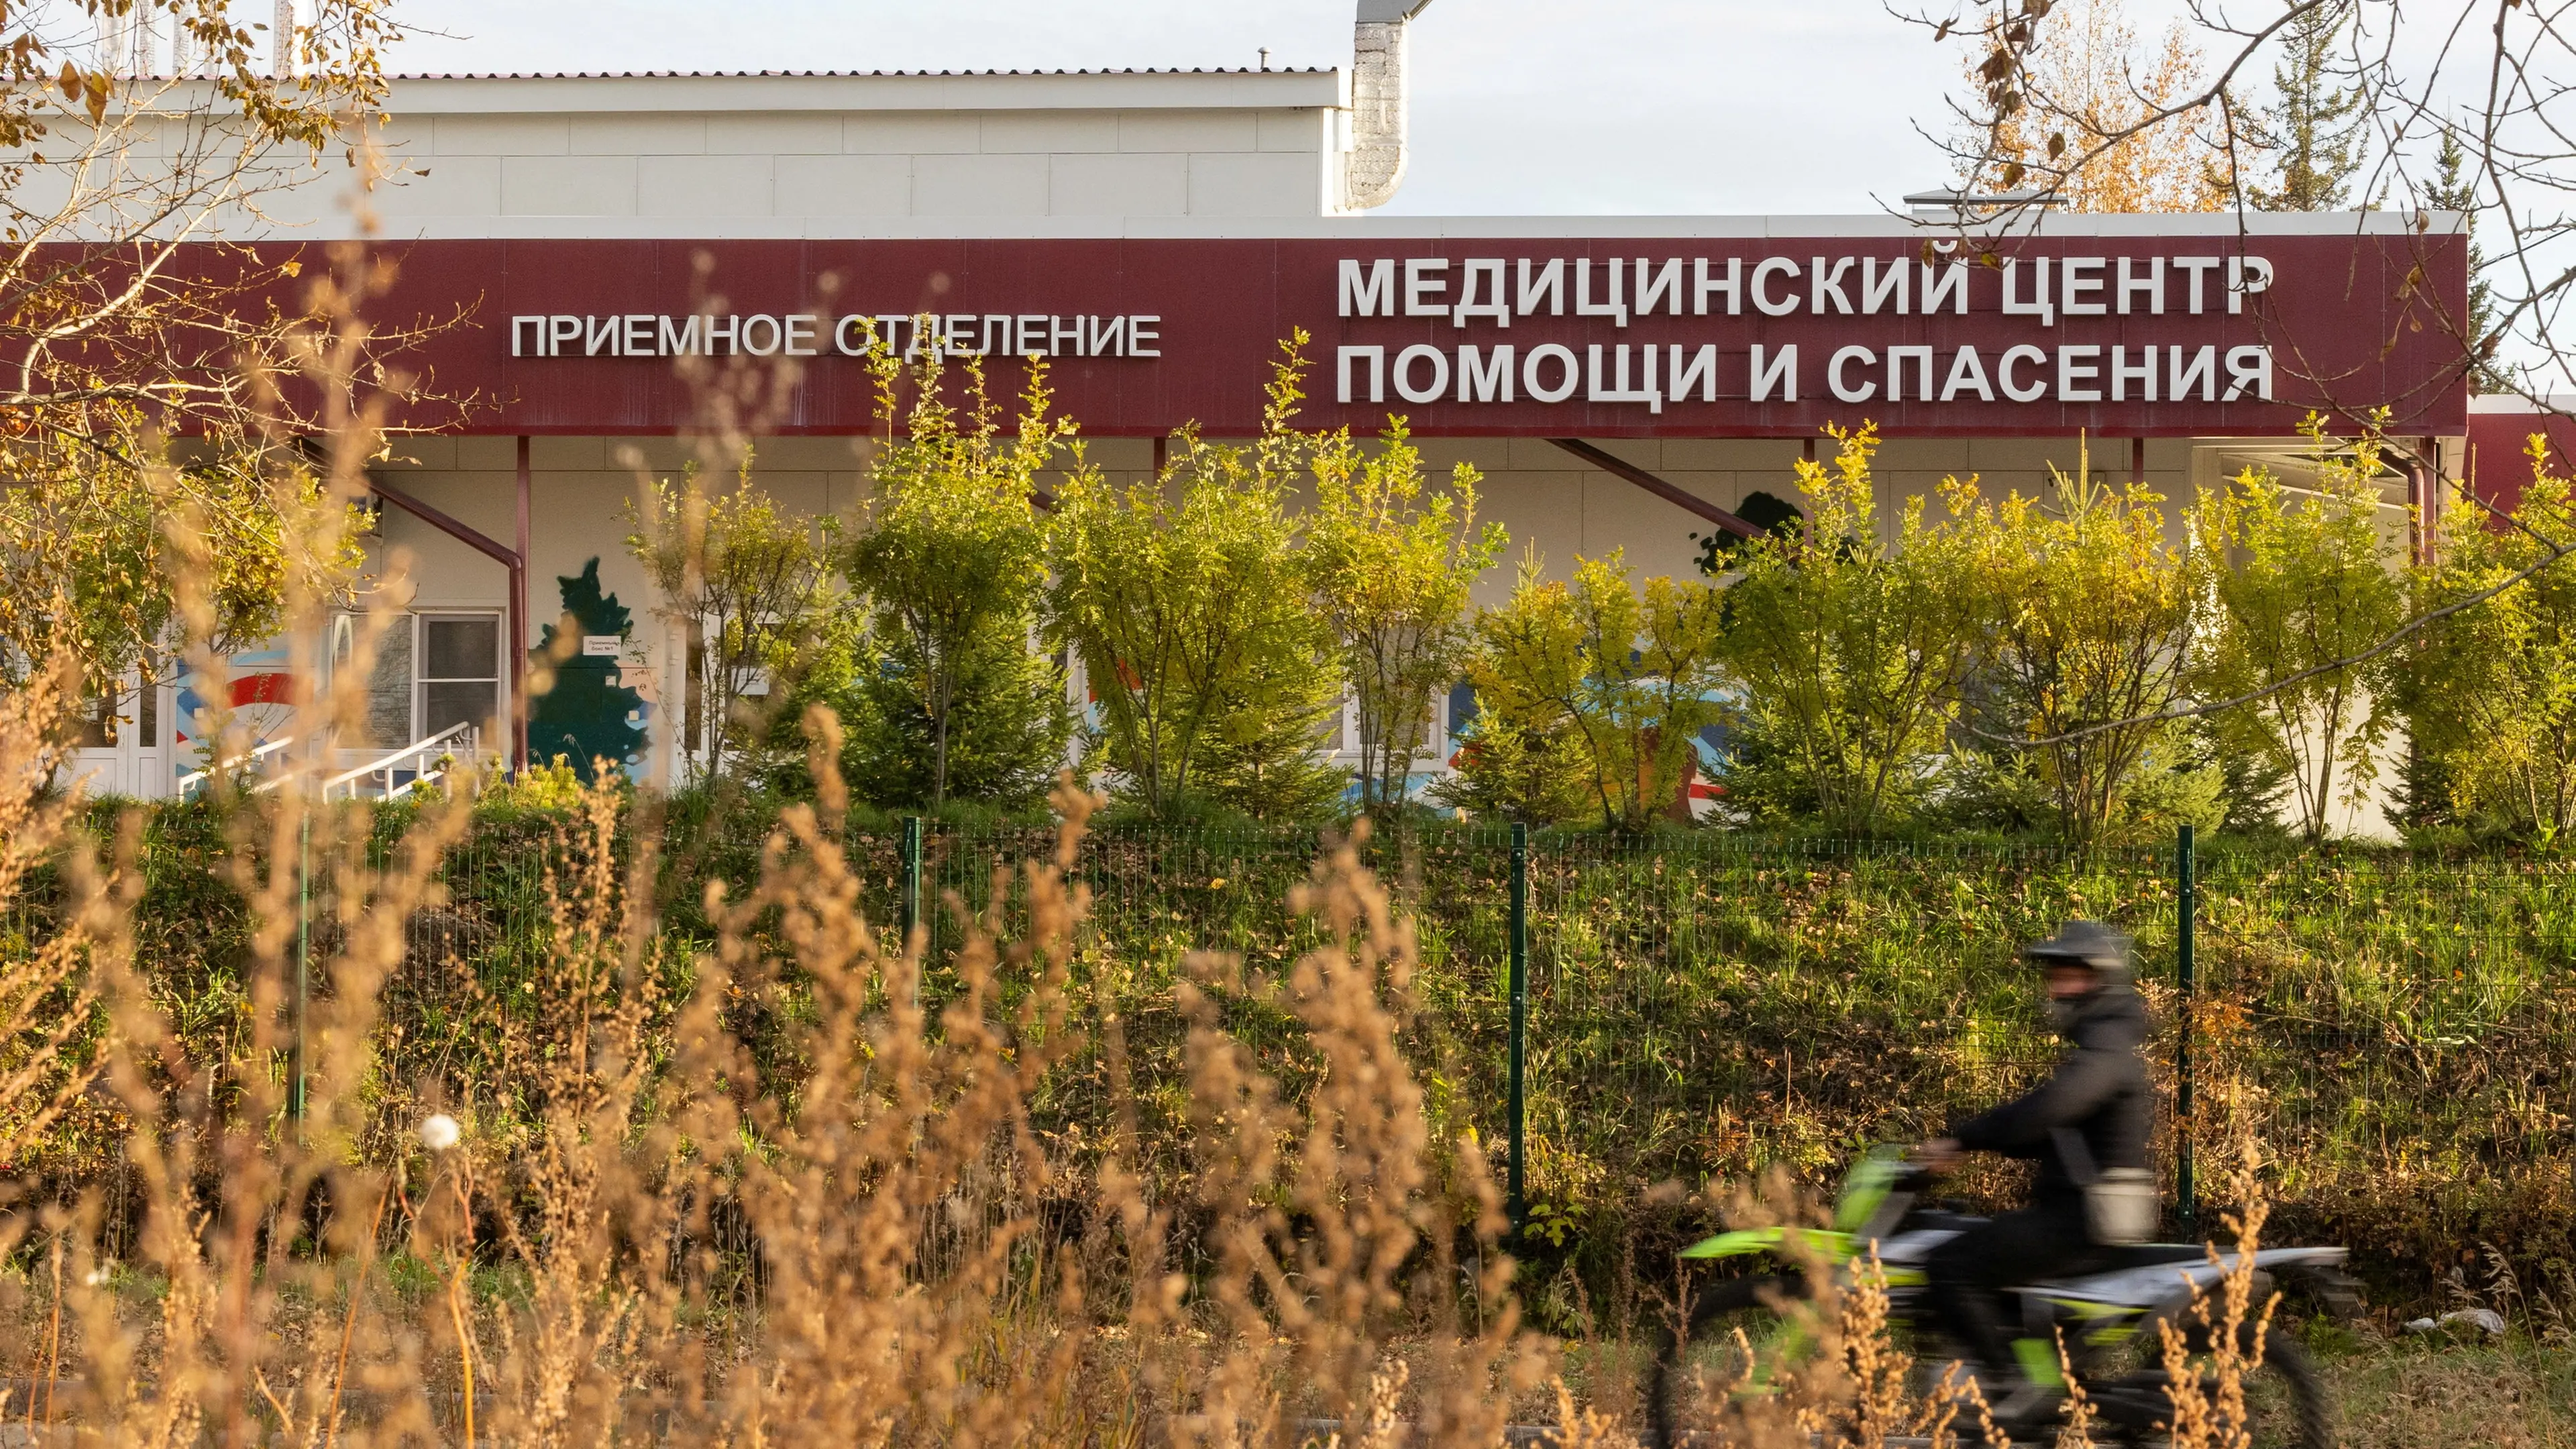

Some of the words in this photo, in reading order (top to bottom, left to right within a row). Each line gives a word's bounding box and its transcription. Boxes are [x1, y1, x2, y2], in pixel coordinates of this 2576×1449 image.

[1338, 240, 1968, 327] МЕДИЦИНСКИЙ
[2002, 256, 2273, 327] ЦЕНТР
[512, 314, 817, 356] ПРИЕМНОЕ
[835, 314, 1161, 364] ОТДЕЛЕНИЕ
[1338, 343, 1716, 414] ПОМОЩИ
[1750, 344, 1797, 402] И
[1827, 343, 2272, 402] СПАСЕНИЯ
